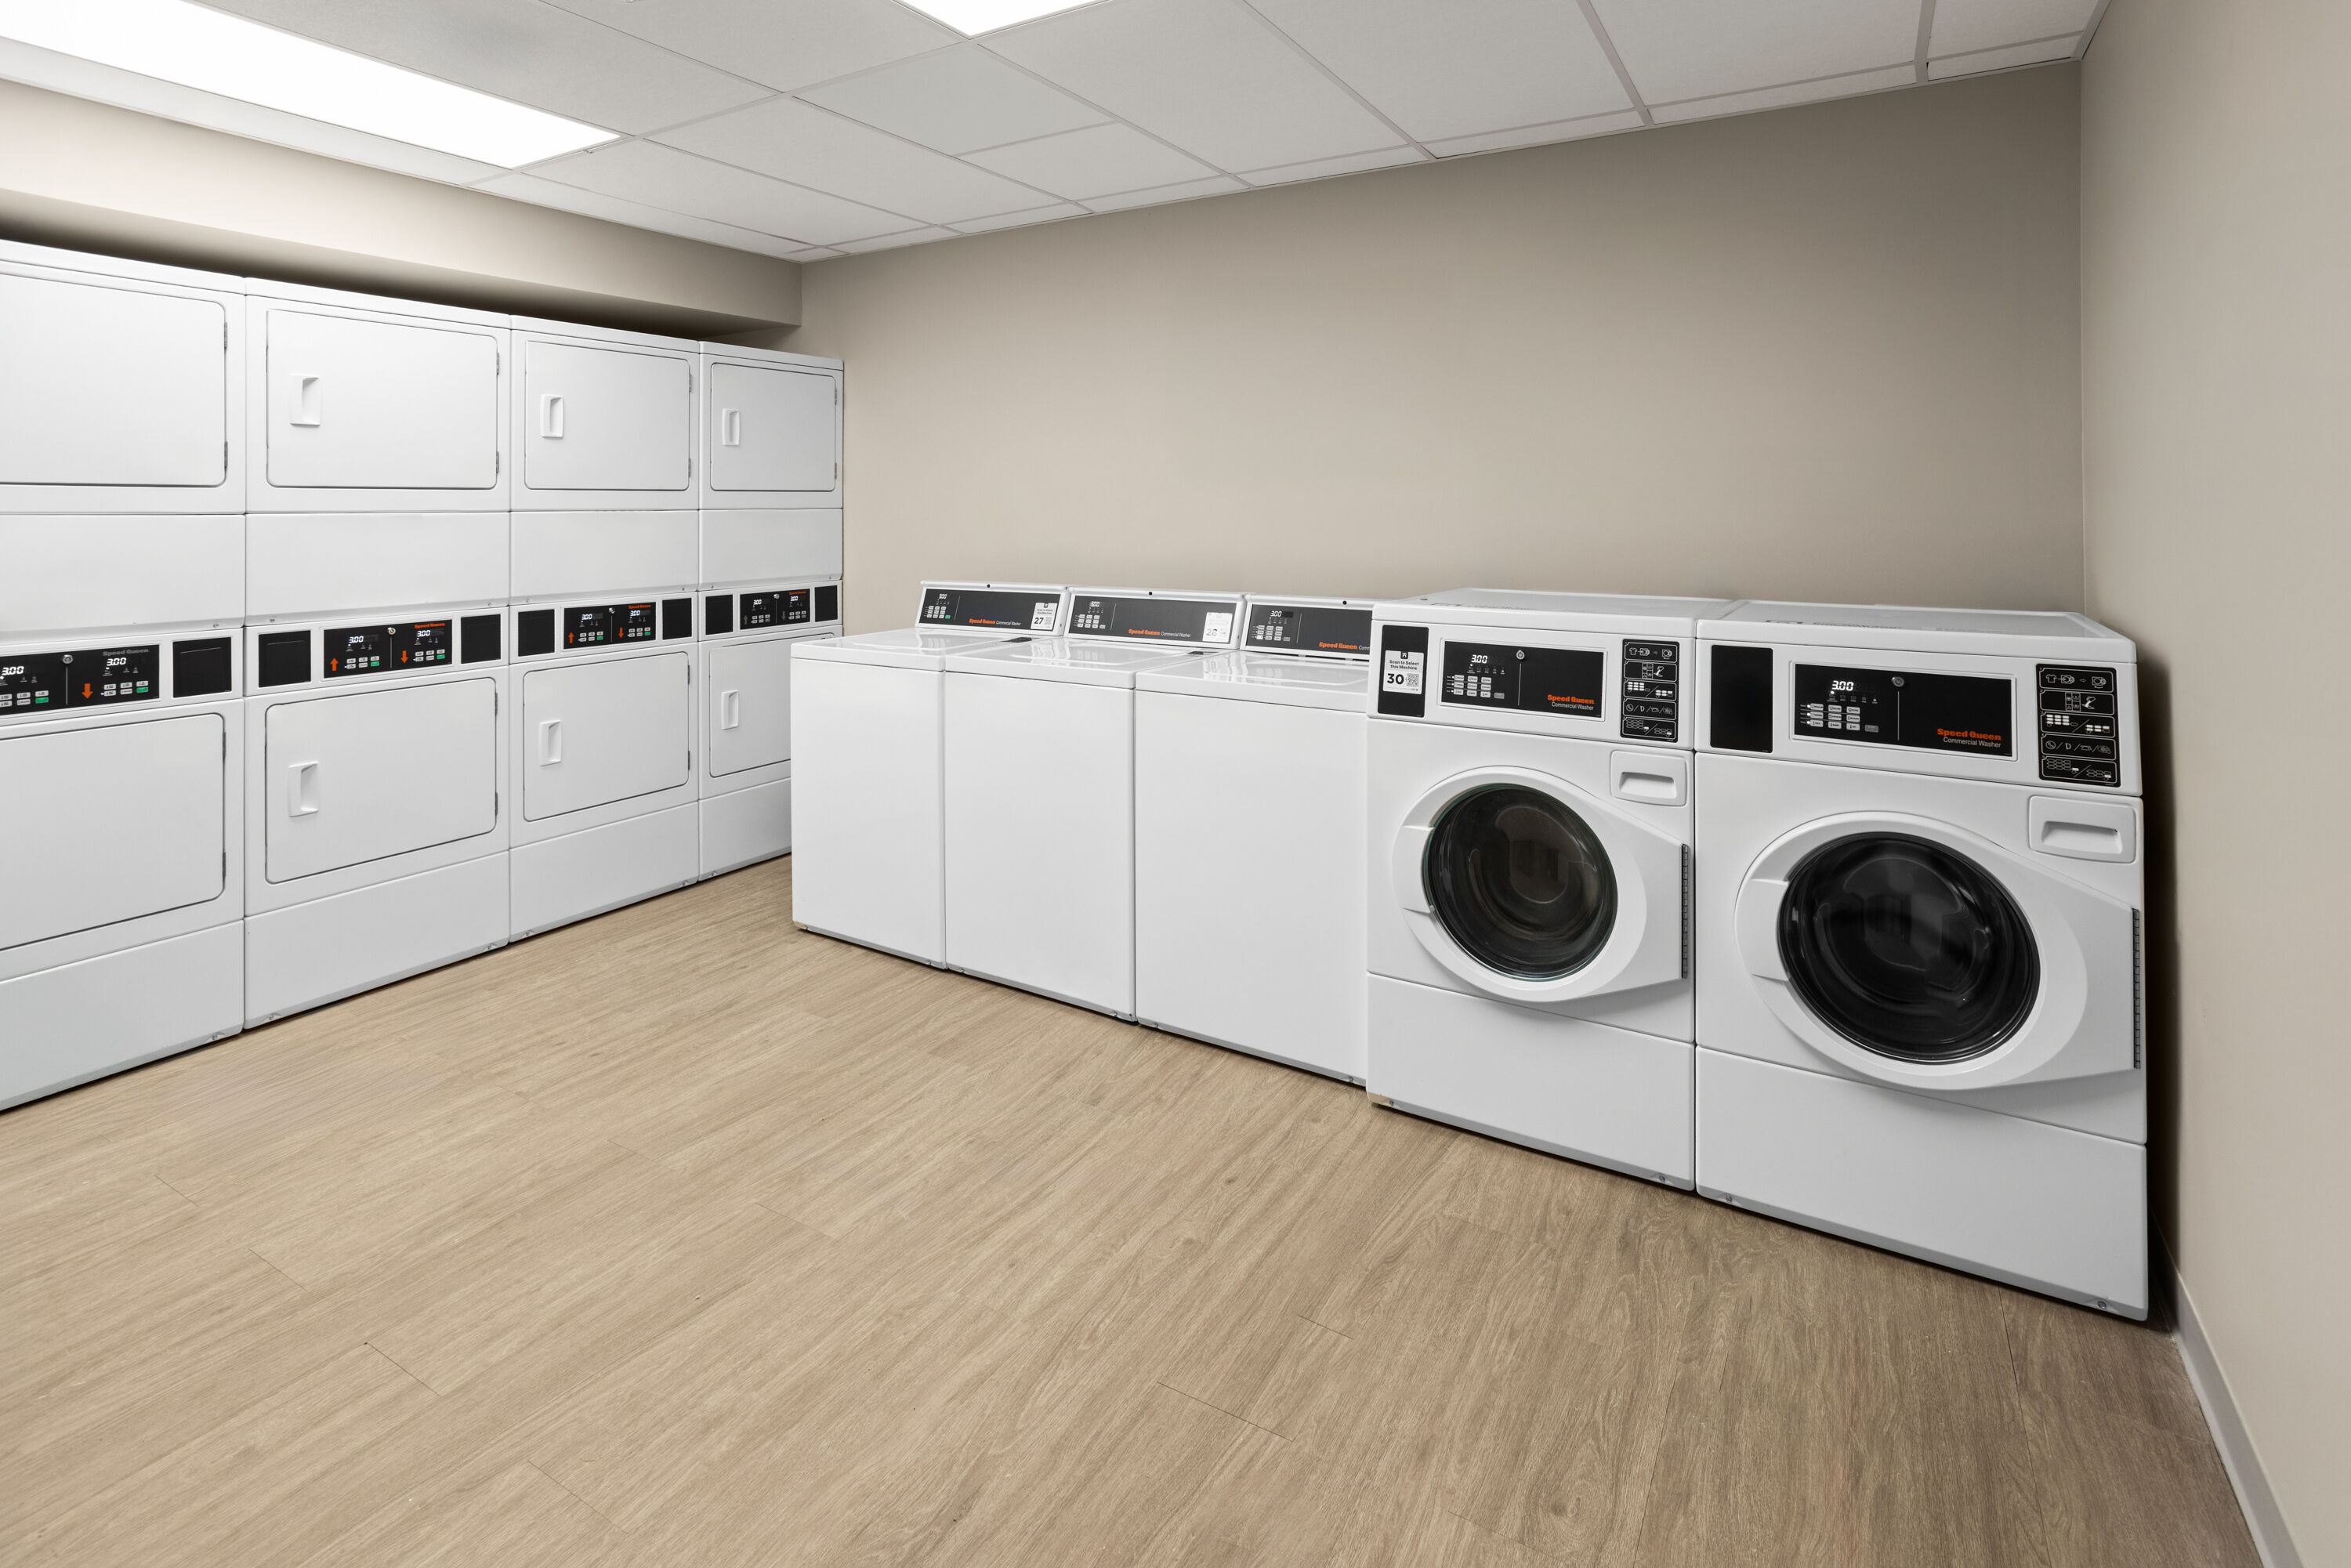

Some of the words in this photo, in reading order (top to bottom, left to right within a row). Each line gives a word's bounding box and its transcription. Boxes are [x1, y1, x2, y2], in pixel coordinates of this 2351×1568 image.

[107, 657, 126, 666] 3.00
[1471, 654, 1488, 664] 3.00
[2, 665, 24, 675] 3.00
[1386, 673, 1404, 685] 30
[1831, 680, 1854, 691] 3.00
[1570, 696, 1595, 704] Queen
[1937, 728, 1968, 737] Speed
[1969, 731, 2001, 741] Queen
[1943, 737, 1978, 746] Commercial
[1979, 740, 2001, 748] Washer
